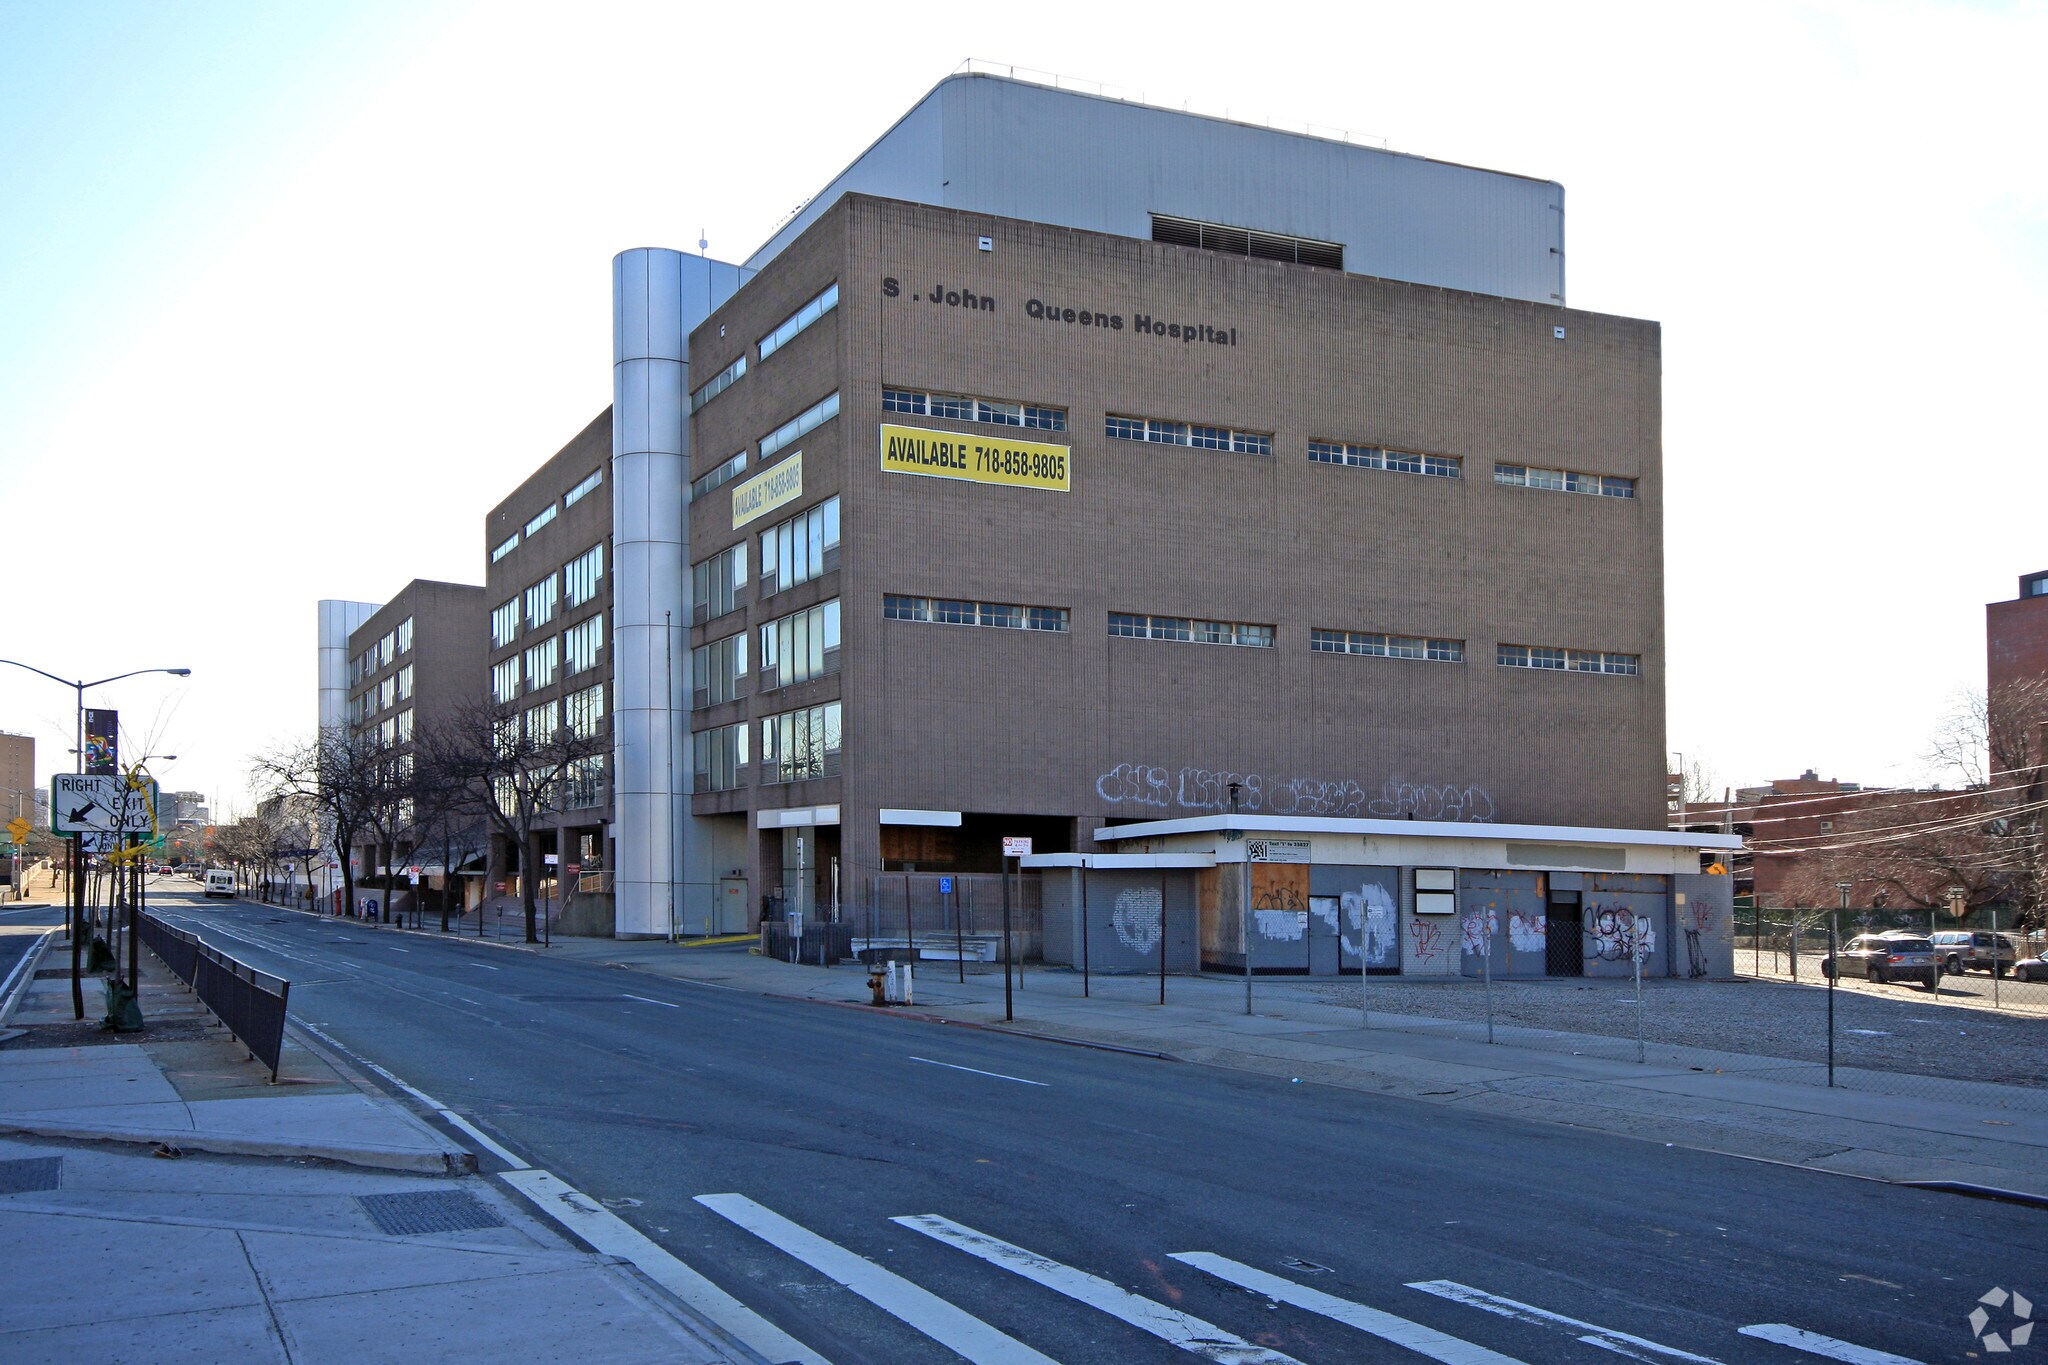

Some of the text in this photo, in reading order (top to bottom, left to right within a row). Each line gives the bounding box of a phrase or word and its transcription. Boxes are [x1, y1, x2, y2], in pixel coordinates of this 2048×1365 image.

[929, 284, 995, 312] John
[1026, 299, 1124, 330] Queens
[1134, 313, 1236, 346] Hospital
[887, 436, 1065, 481] AVAILABLE 718-858-9805
[735, 484, 762, 518] AVAILABLE
[62, 779, 101, 792] RIGHT
[113, 798, 144, 810] EXIT
[110, 815, 149, 828] ONLY
